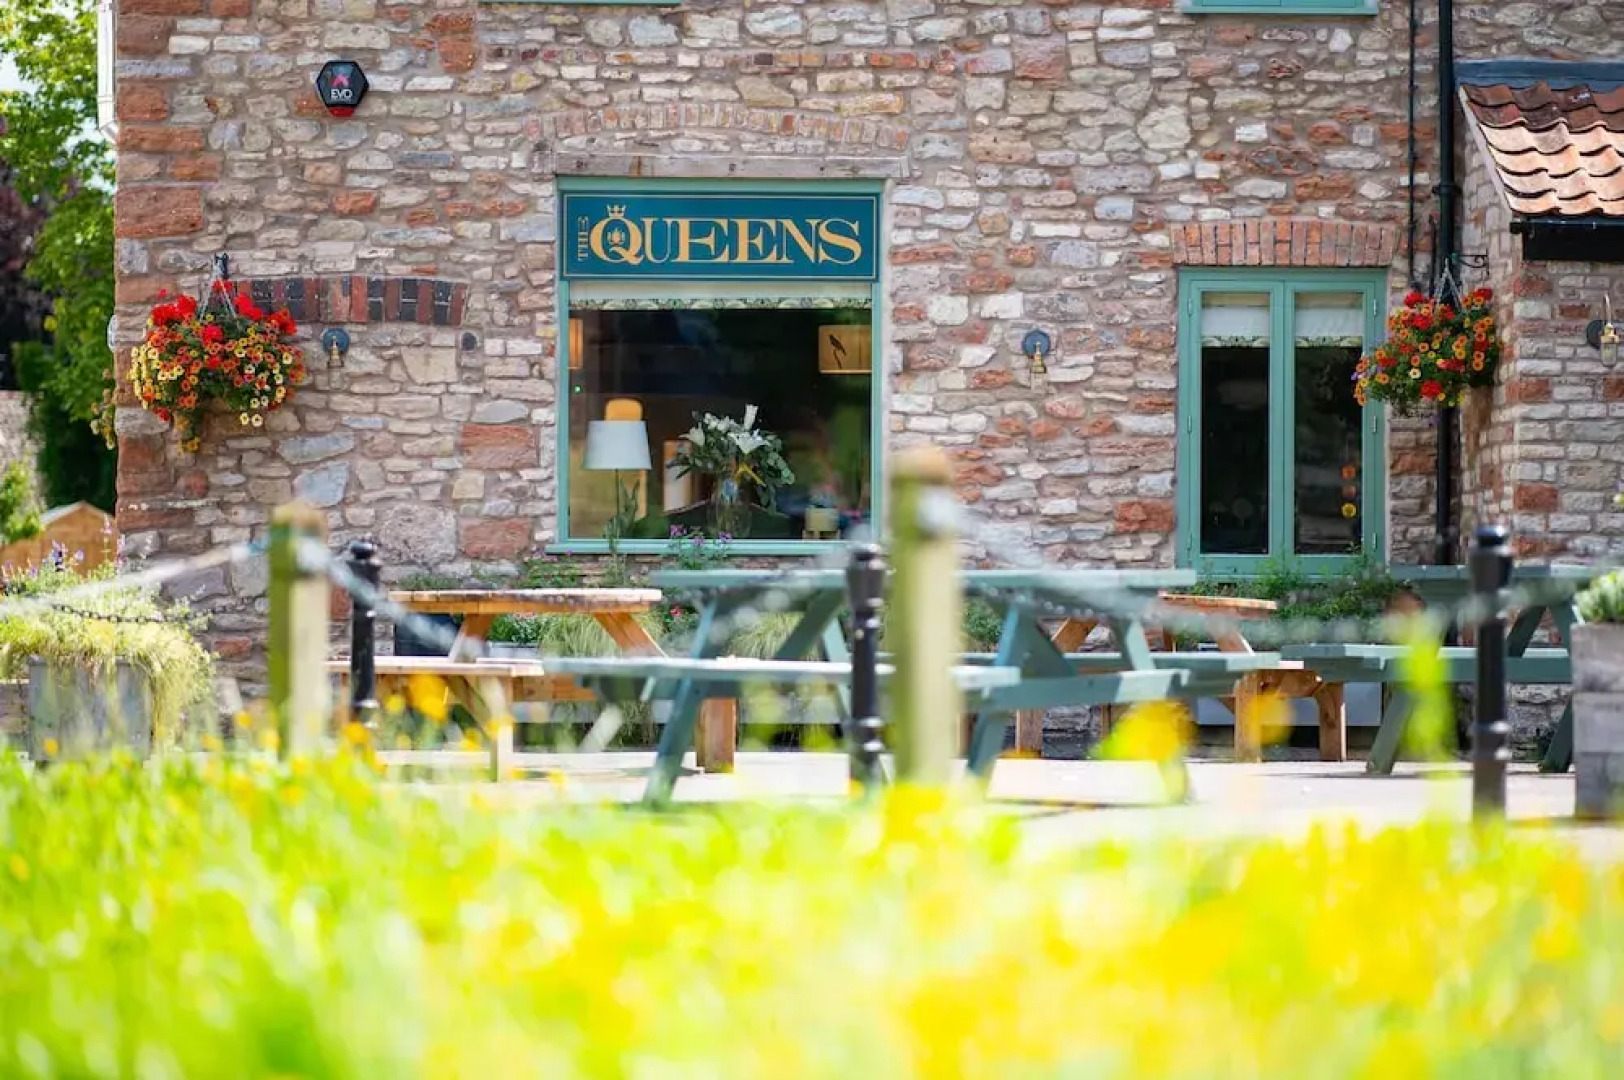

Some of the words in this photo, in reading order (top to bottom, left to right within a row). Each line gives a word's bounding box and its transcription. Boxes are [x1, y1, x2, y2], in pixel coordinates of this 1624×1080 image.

[331, 88, 353, 98] EVO
[577, 215, 589, 262] THE
[589, 216, 862, 265] QUEENS
